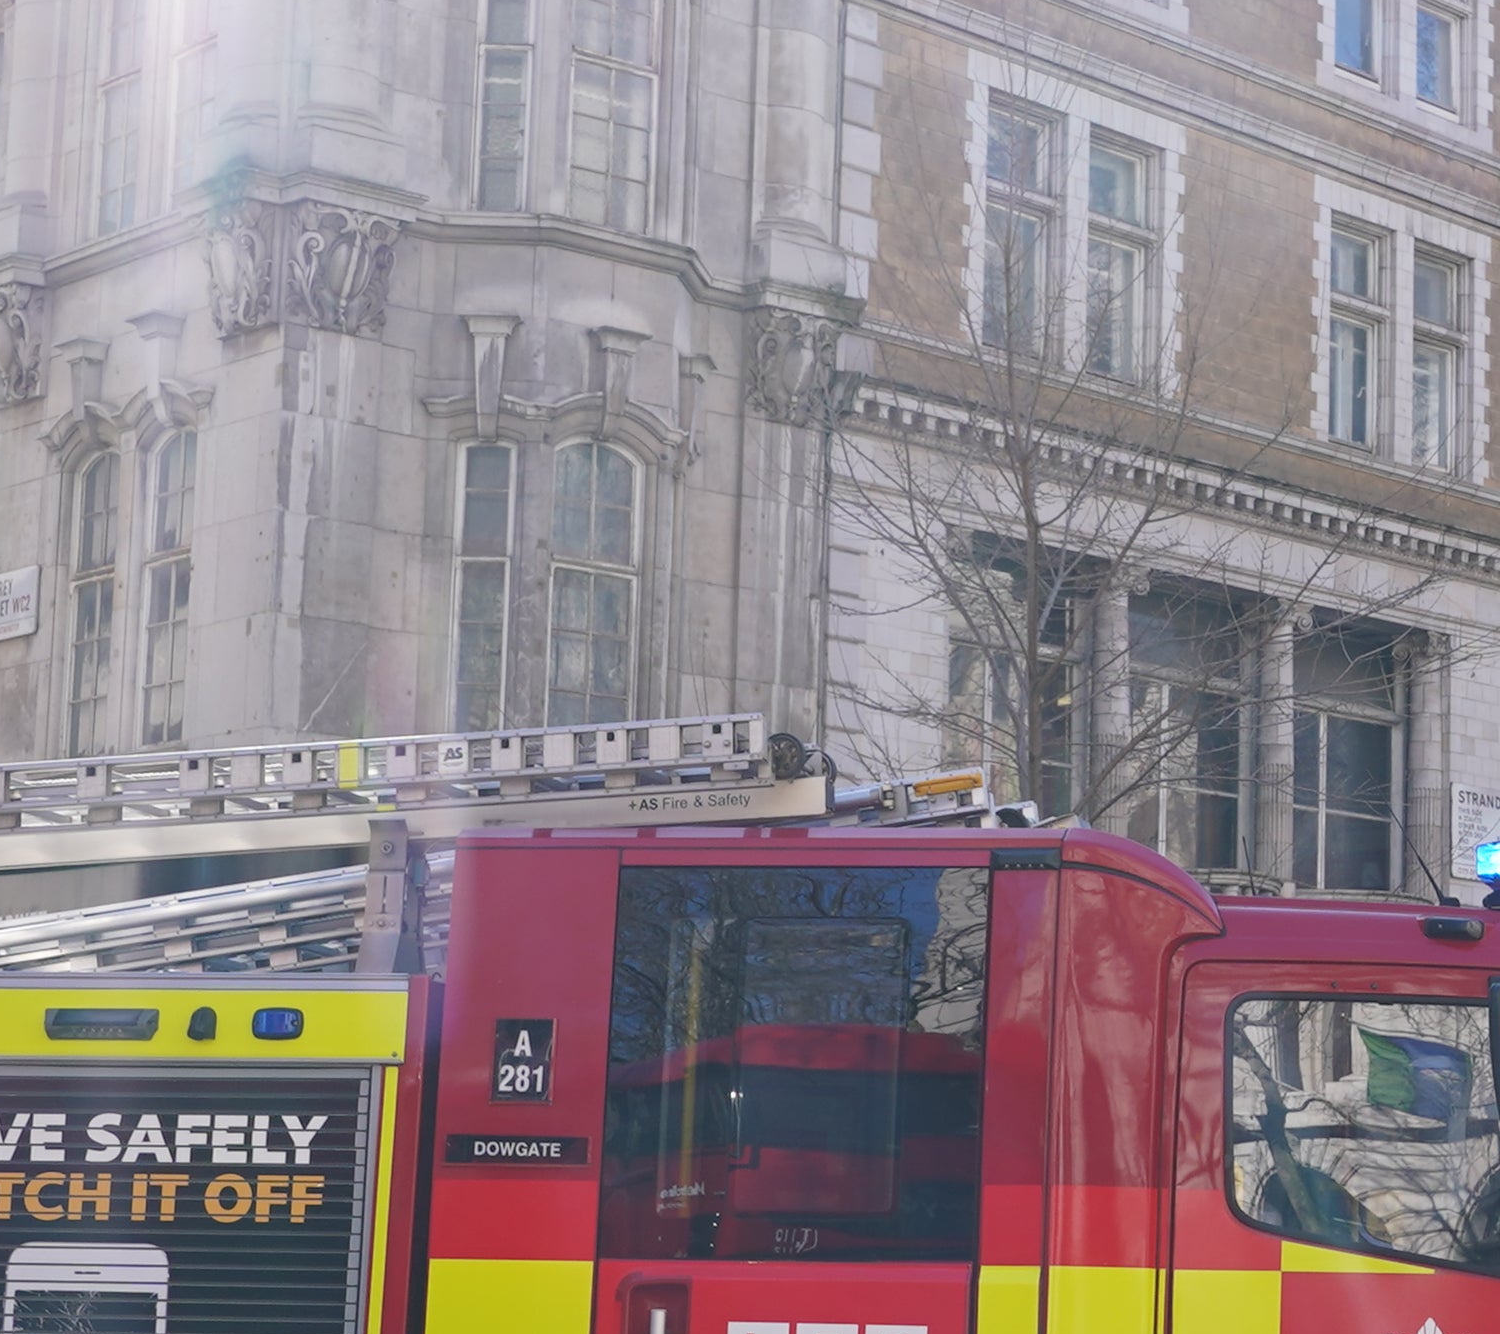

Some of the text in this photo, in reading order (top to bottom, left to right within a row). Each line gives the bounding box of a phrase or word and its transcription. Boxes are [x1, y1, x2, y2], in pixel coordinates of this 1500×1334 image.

[12, 594, 31, 614] WC2
[513, 1029, 533, 1058] A
[497, 1064, 545, 1093] 281
[84, 1112, 329, 1165] SAFELY
[473, 1140, 561, 1158] DOWGATE
[130, 1172, 190, 1222] IT
[203, 1172, 325, 1224] OFF
